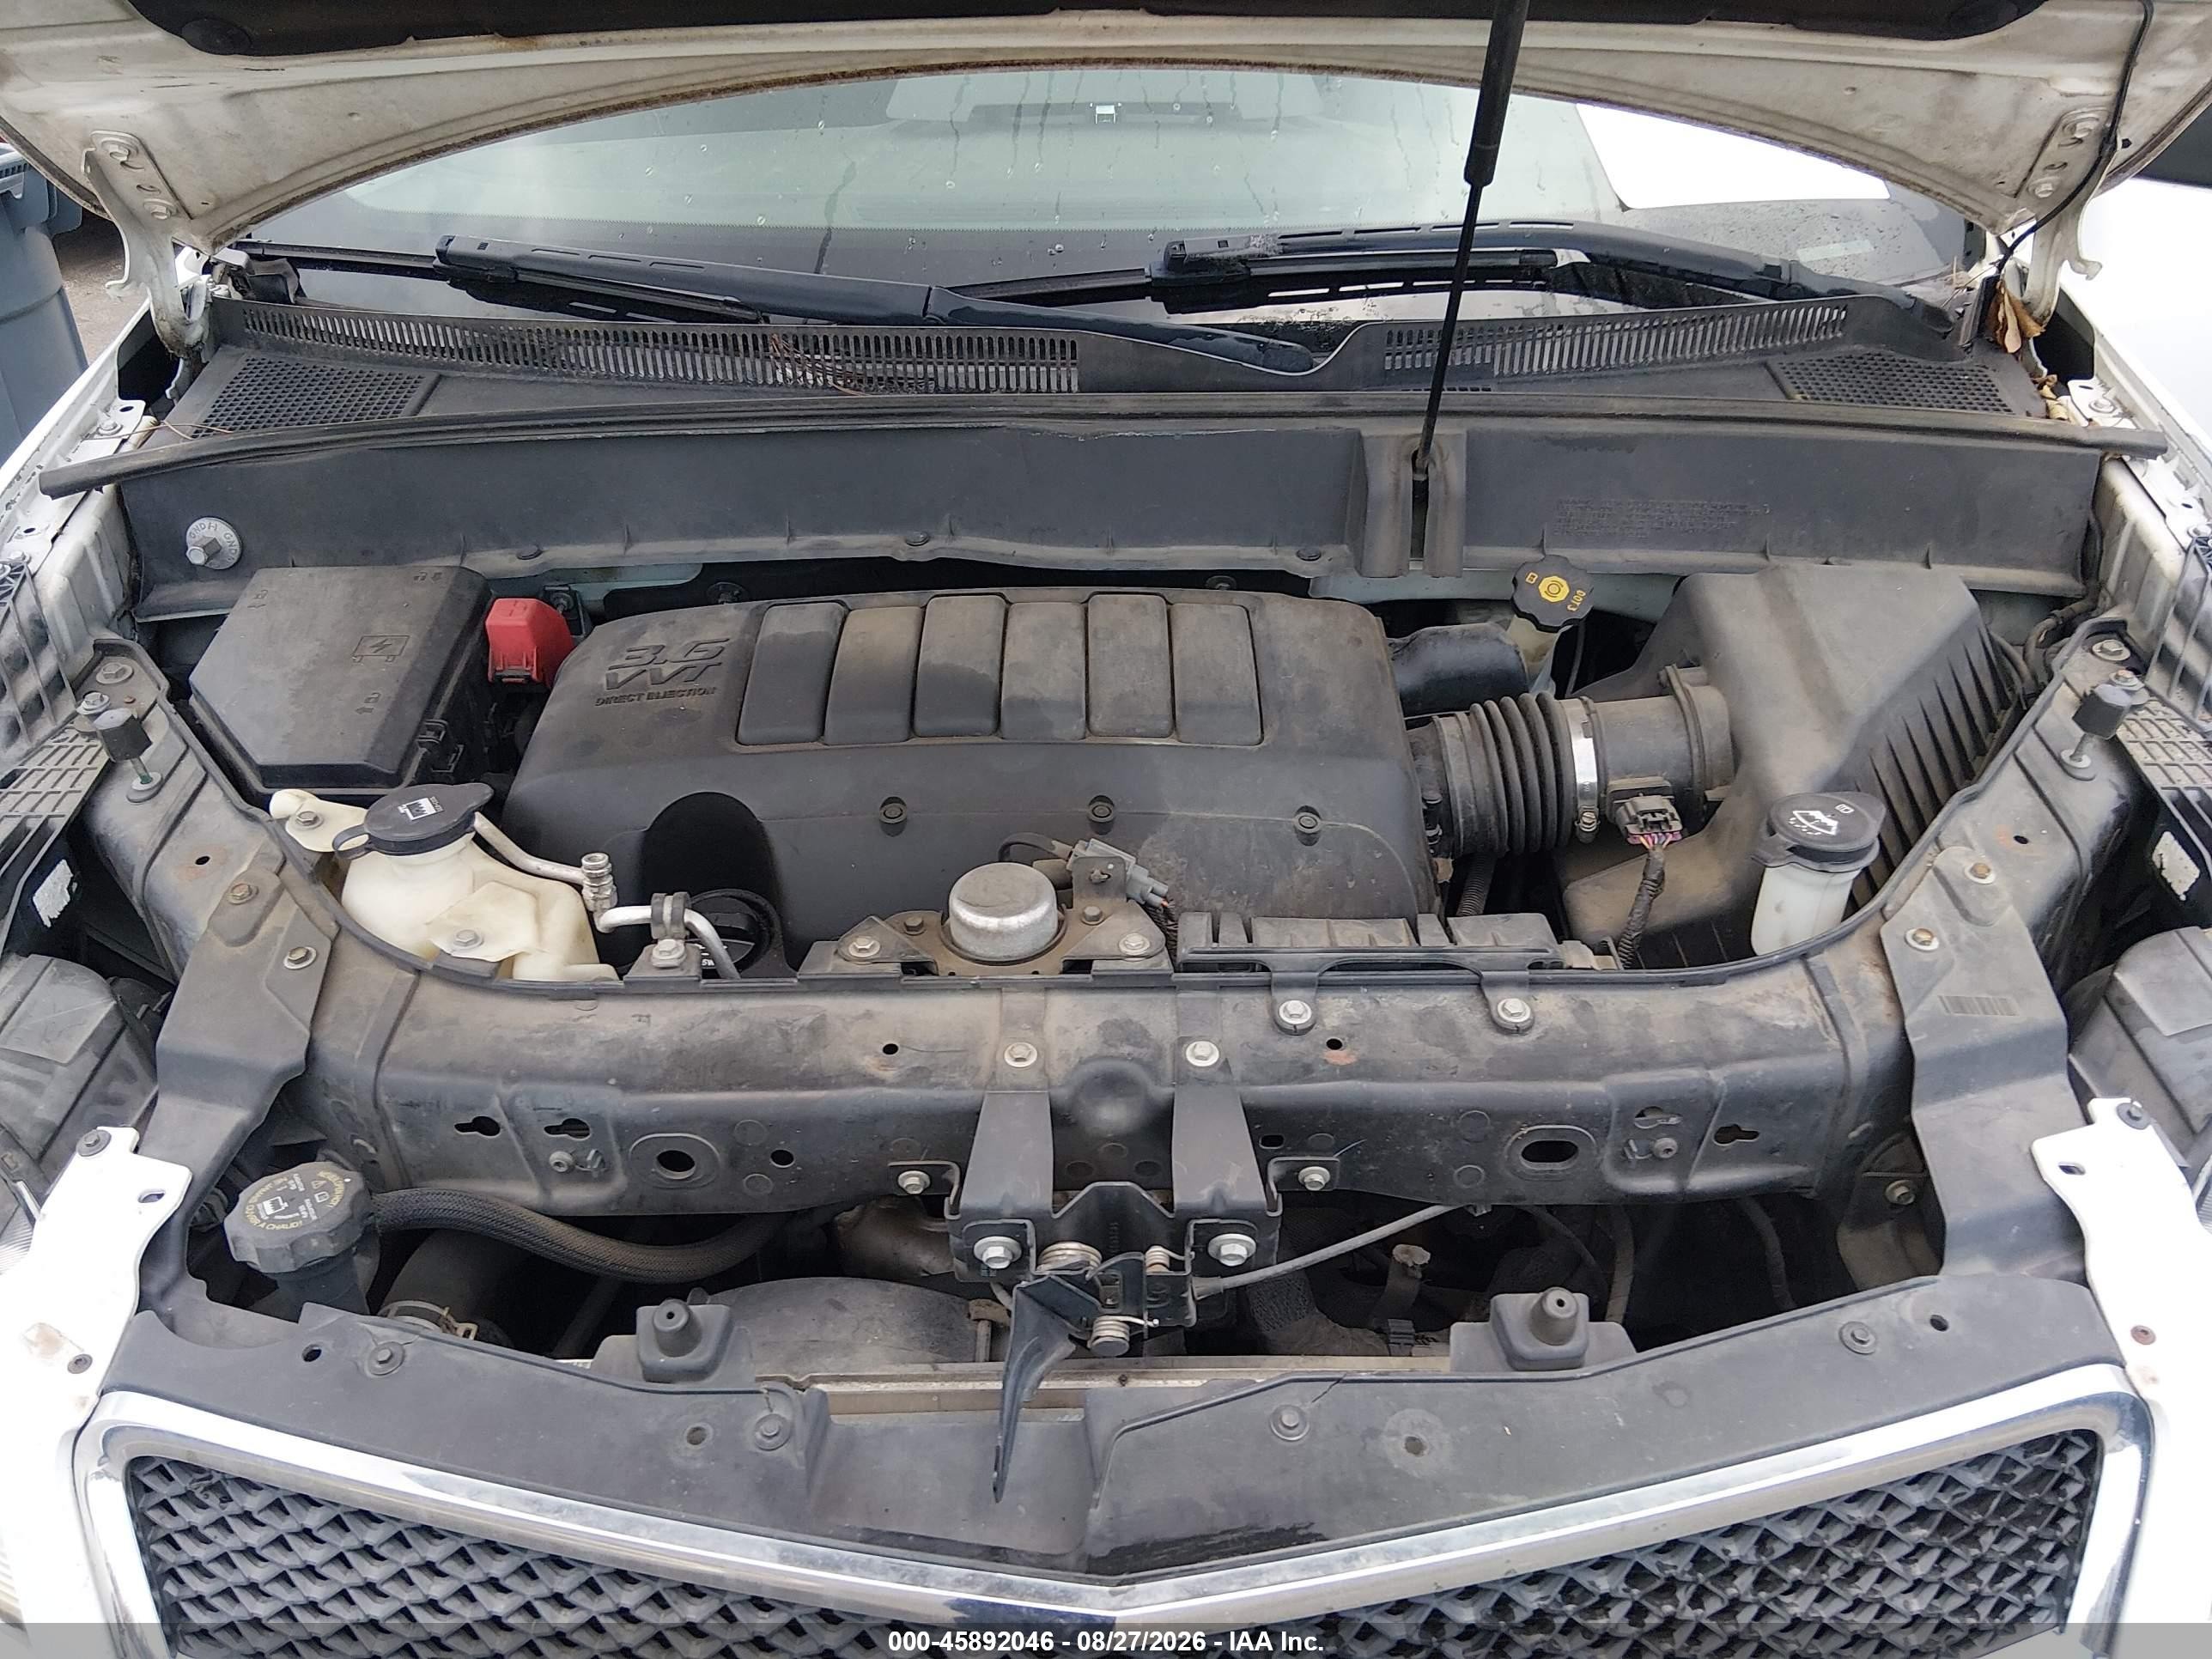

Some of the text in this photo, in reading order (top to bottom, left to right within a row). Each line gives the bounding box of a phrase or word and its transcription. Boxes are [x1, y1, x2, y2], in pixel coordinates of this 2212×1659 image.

[607, 637, 731, 671] 3.6
[605, 661, 723, 690] VVT
[594, 686, 718, 707] DIRECT INJECTION
